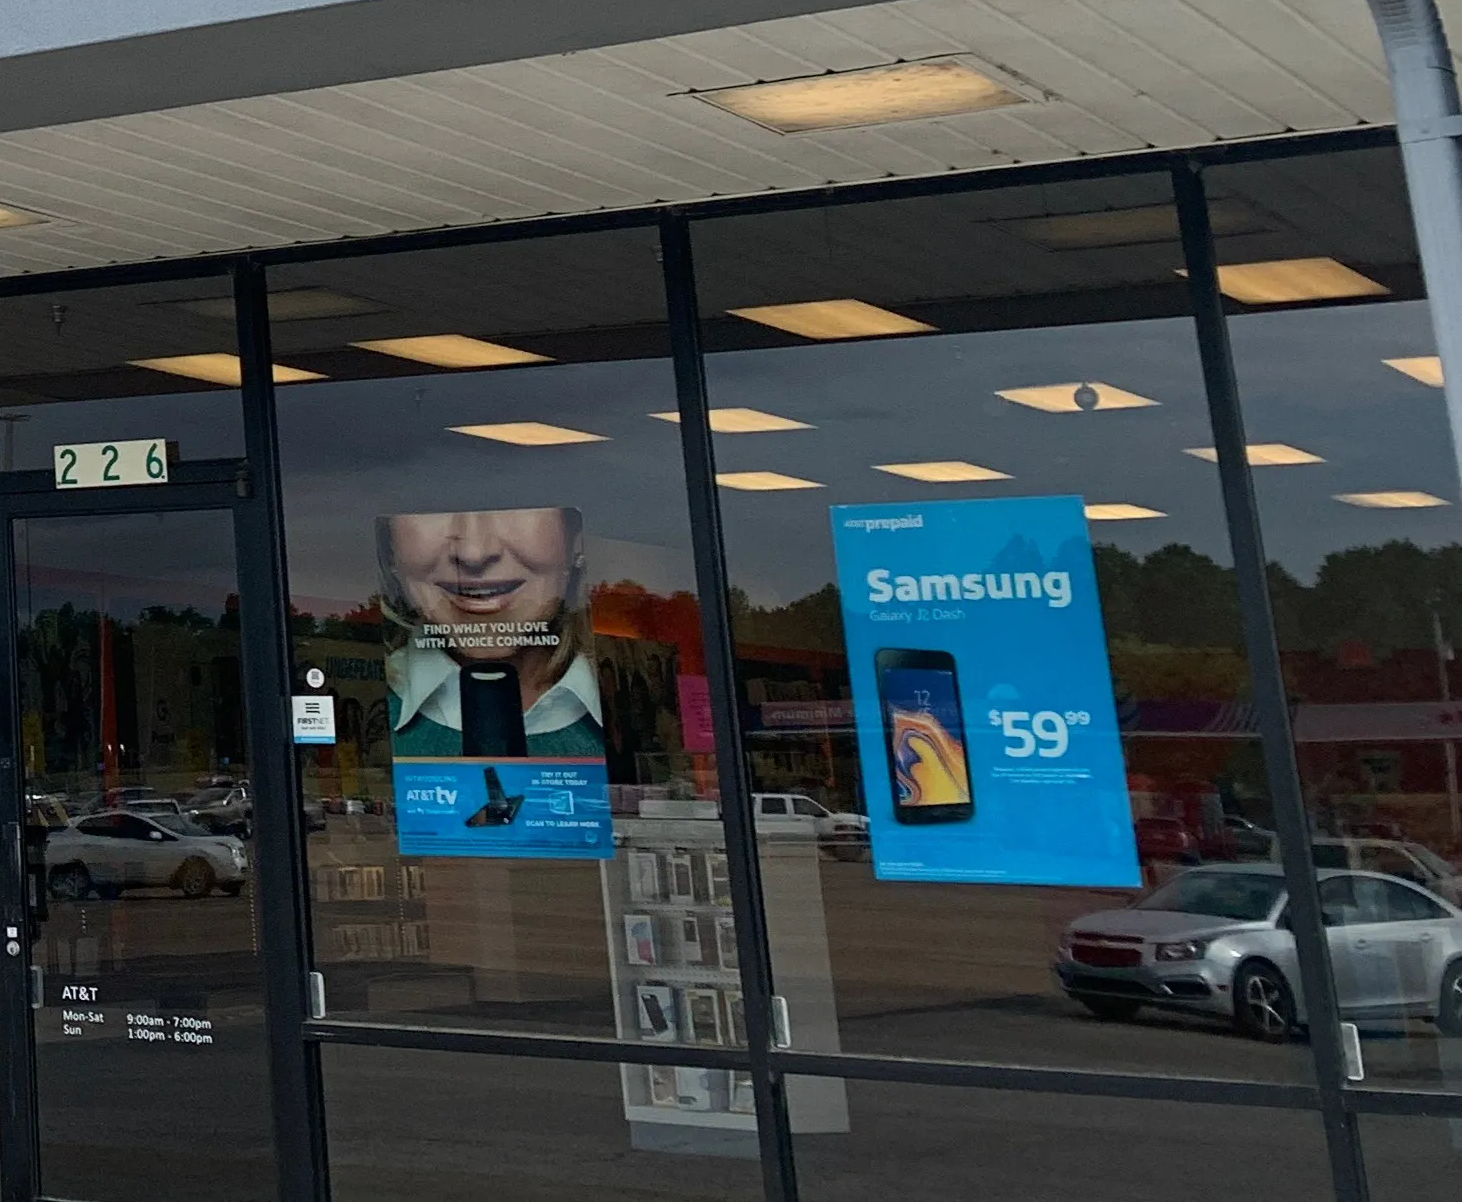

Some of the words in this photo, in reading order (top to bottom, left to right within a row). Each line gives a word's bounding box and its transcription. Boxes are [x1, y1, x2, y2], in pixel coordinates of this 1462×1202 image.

[59, 443, 163, 484] 226
[865, 515, 924, 533] prepaid
[866, 568, 1072, 608] Samsung
[870, 610, 912, 623] Galaxy
[933, 608, 966, 621] Dash
[424, 624, 450, 635] FIND
[453, 623, 487, 634] WHAT
[489, 623, 514, 633] YOU
[517, 622, 548, 632] LOVE
[415, 638, 445, 648] WITH
[448, 637, 457, 647] A
[459, 636, 493, 647] VOICE
[496, 636, 560, 646] COMMAND
[406, 789, 435, 801] AT&T
[62, 986, 98, 1001] AT&T
[63, 1010, 104, 1023] Mon-Sat
[126, 1014, 164, 1027] 9:00am
[173, 1016, 212, 1030] 7:00pm
[63, 1024, 82, 1036] Sun
[128, 1029, 165, 1042] 1:00pm
[174, 1031, 213, 1045] 6:00pm
